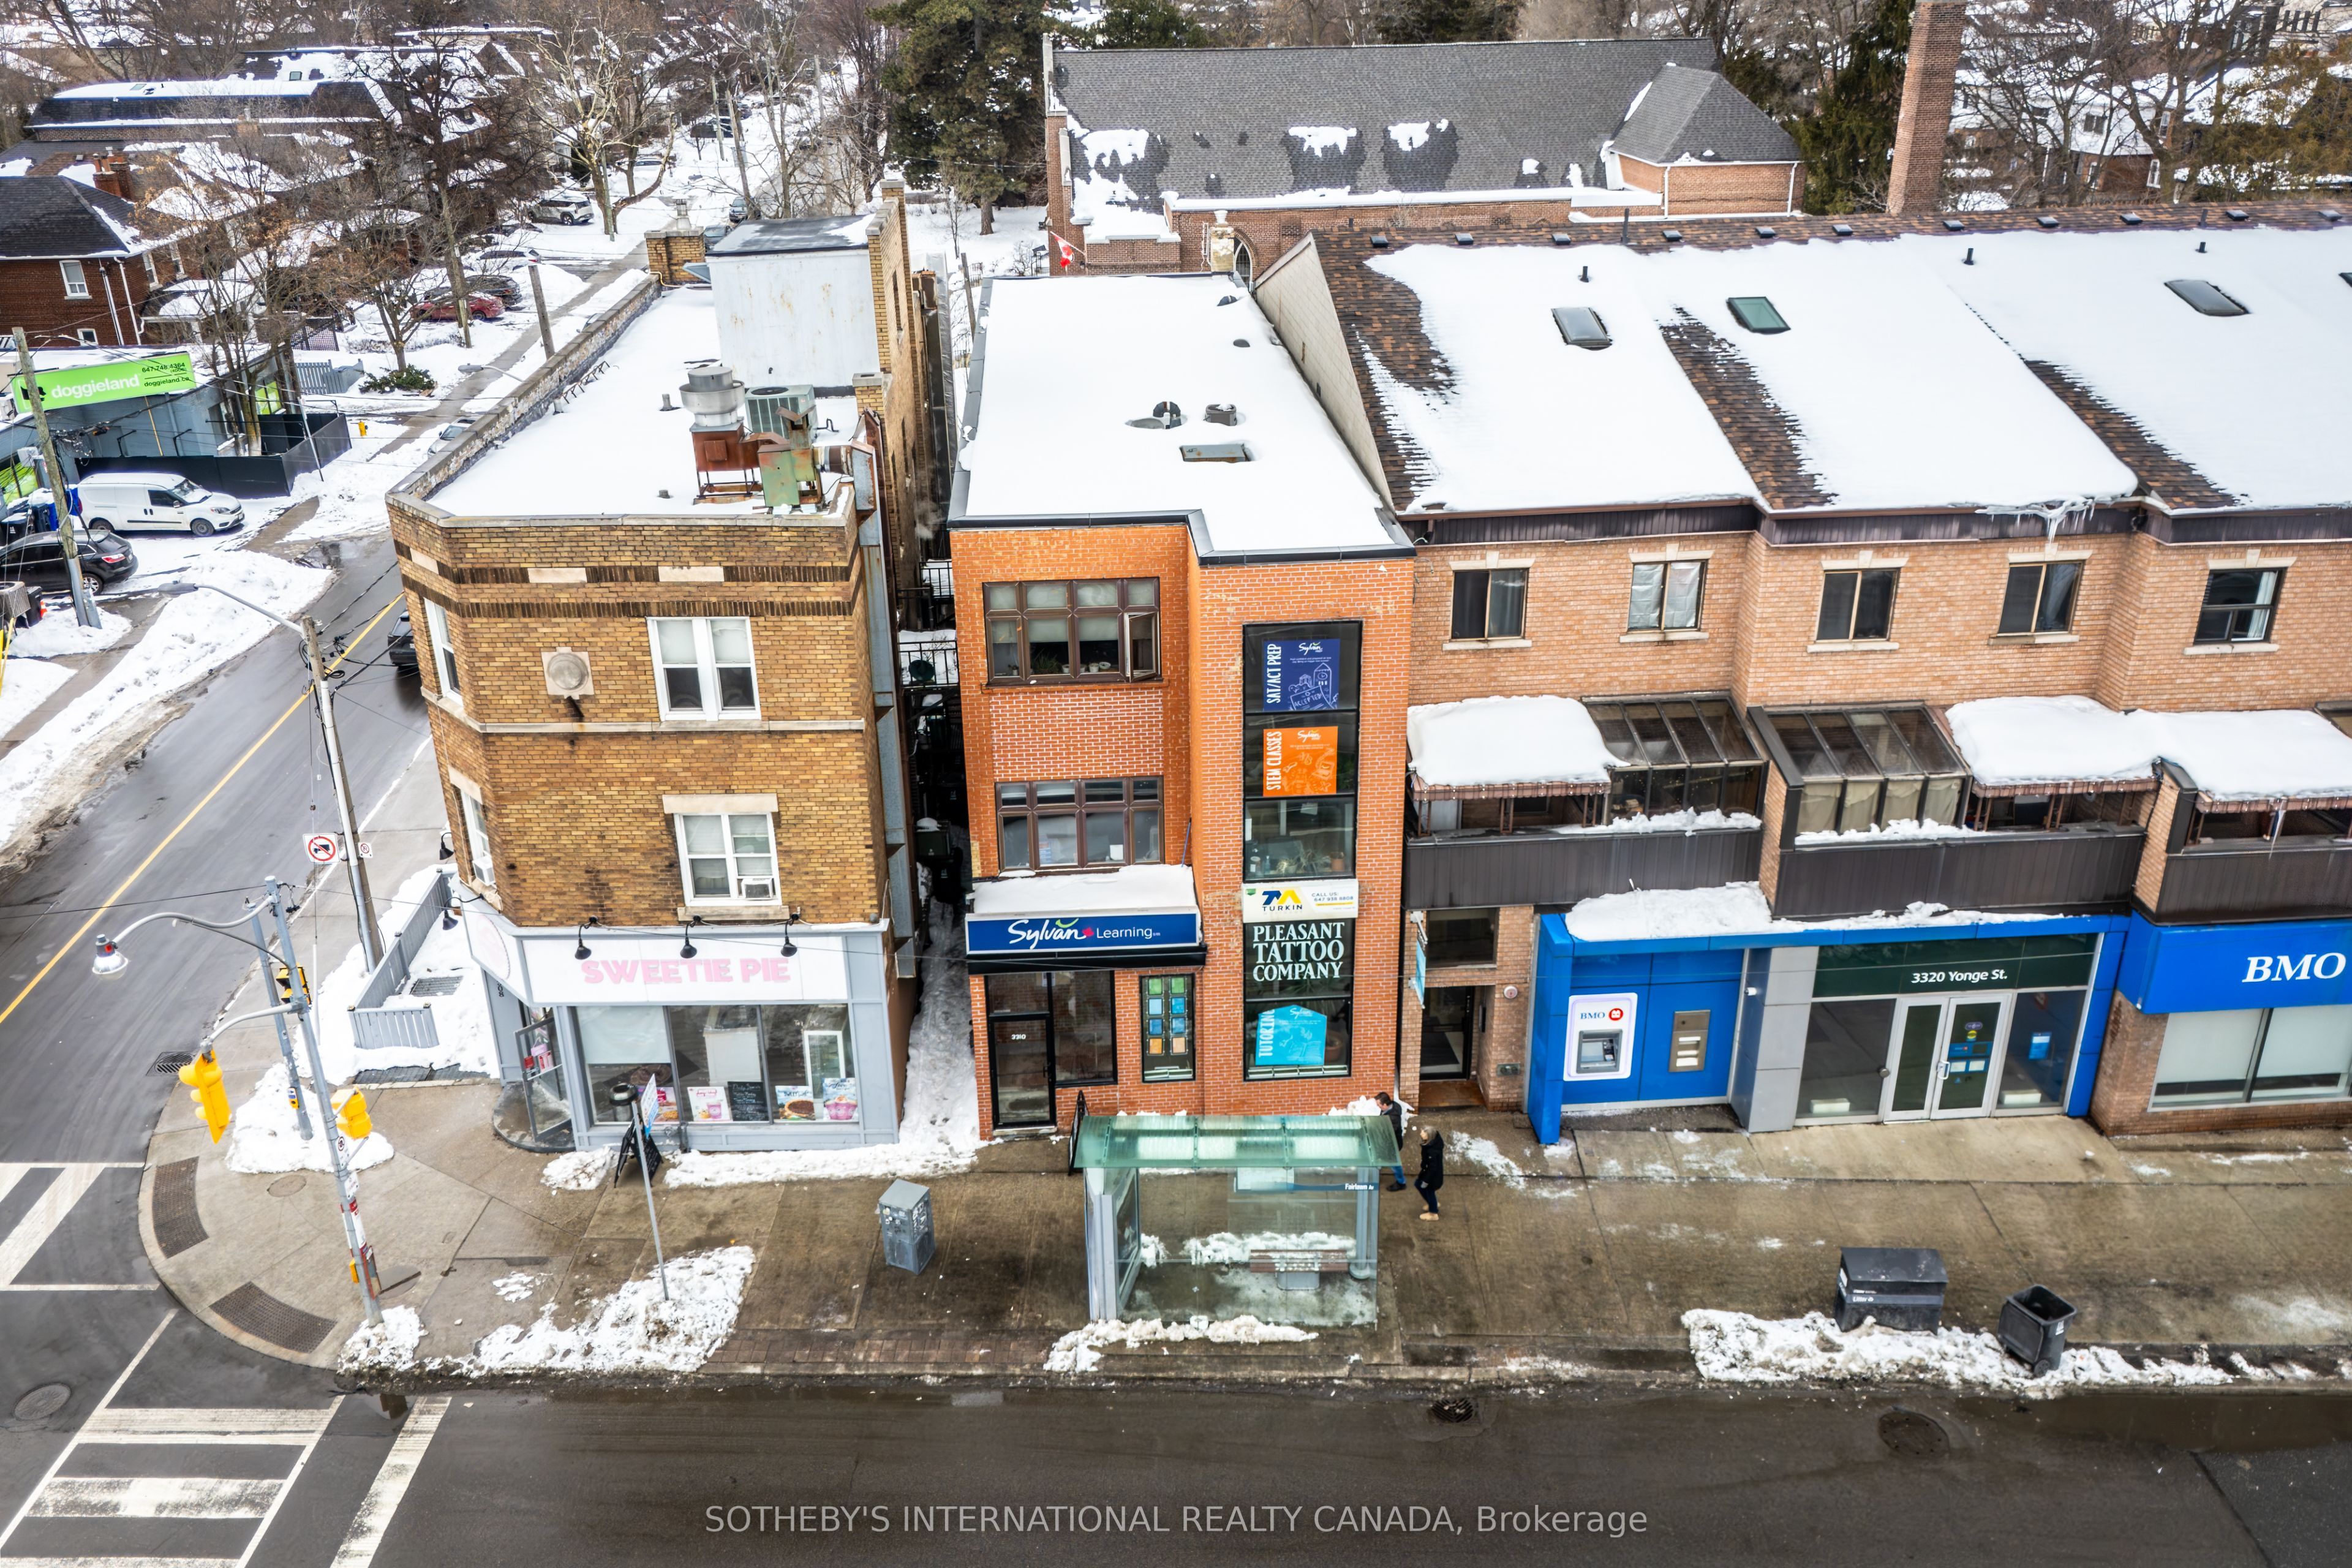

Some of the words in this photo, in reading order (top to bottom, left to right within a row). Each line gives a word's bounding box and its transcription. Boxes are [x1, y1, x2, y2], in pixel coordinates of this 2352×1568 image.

[141, 363, 185, 372] 647.748.4364
[51, 374, 140, 399] doggieland
[144, 377, 189, 386] doggieland.ca
[1267, 644, 1281, 665] PREP
[1298, 642, 1322, 655] Sylvan
[1267, 668, 1281, 704] SAT/ACT
[1266, 731, 1282, 766] CLASSES
[1266, 768, 1281, 790] STEM
[1008, 918, 1087, 949] Sylvan
[1096, 927, 1152, 939] Learning
[1253, 922, 1345, 942] PLEASANT
[1253, 939, 1344, 963] TATTOO
[581, 958, 734, 985] SWEETIE
[739, 957, 791, 984] PIE
[1253, 962, 1344, 982] COMPANY
[1911, 971, 1946, 984] 3320
[1948, 971, 1989, 983] Yonge
[1991, 969, 2008, 980] St.
[2242, 952, 2346, 982] BMO
